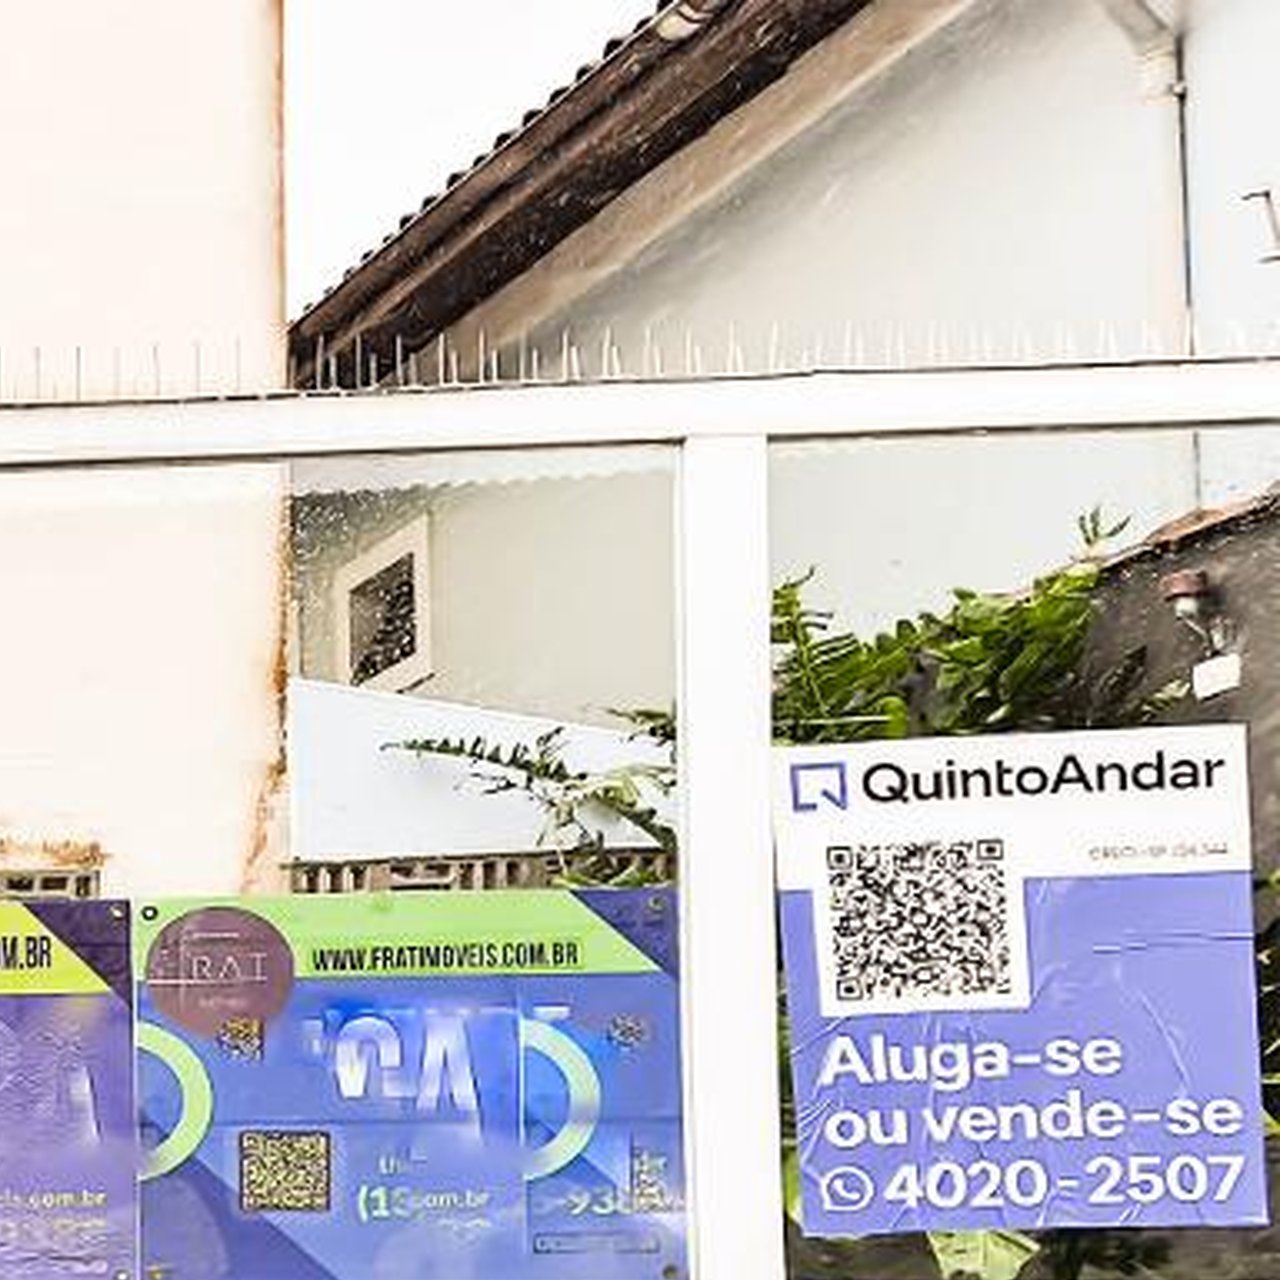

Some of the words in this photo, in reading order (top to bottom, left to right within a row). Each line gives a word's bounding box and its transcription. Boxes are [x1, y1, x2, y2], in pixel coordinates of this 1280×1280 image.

[862, 751, 1226, 804] QuintoAndar
[312, 942, 578, 971] WWW.FRATIMOVEIS.COM.BR
[820, 1034, 1122, 1092] Aluga-se
[825, 1109, 908, 1149] ou
[921, 1089, 1243, 1142] vende-se
[884, 1155, 1246, 1210] 4020-2507
